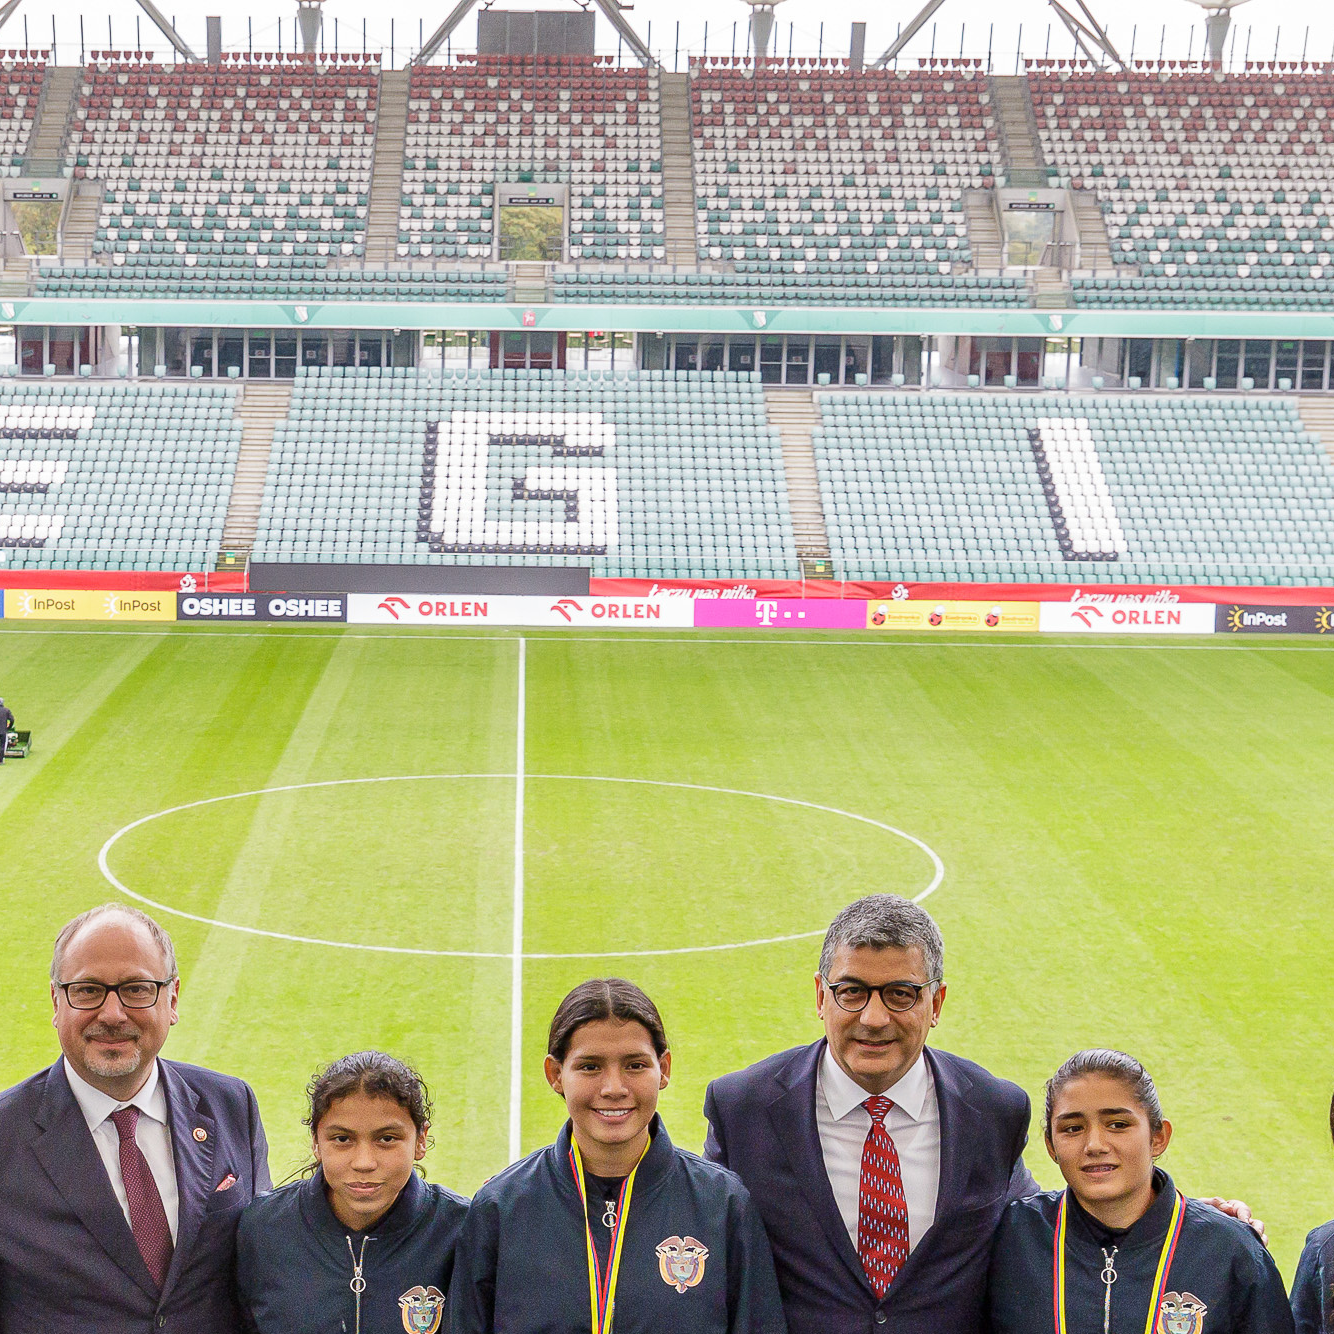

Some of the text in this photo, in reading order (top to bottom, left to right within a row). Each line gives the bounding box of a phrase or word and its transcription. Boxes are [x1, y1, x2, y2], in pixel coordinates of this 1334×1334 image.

[33, 598, 75, 610] InPost
[119, 599, 161, 612] InPost
[182, 597, 256, 616] OSHEE
[268, 598, 343, 617] OSHEE
[418, 601, 488, 617] ORLEN
[591, 603, 660, 619] ORLEN
[1112, 609, 1181, 625] ORLEN
[1242, 611, 1288, 627] InPost
